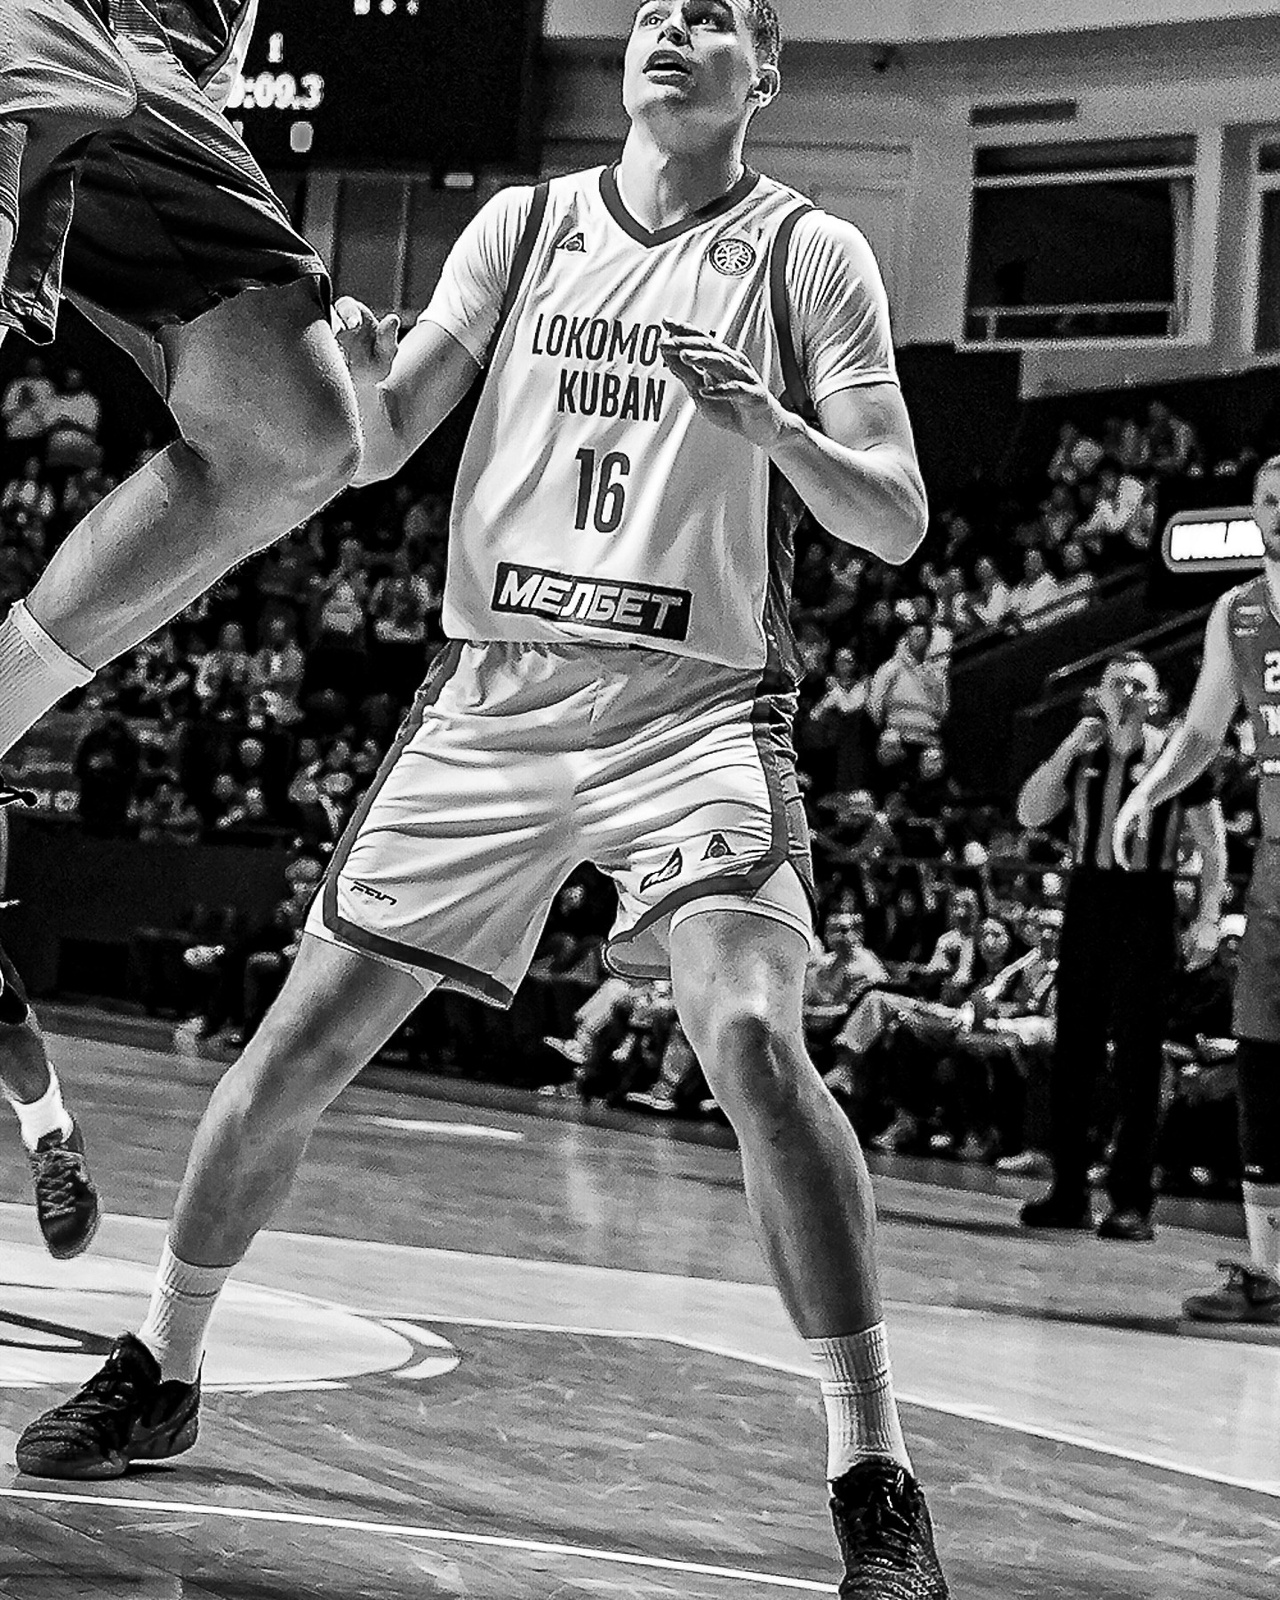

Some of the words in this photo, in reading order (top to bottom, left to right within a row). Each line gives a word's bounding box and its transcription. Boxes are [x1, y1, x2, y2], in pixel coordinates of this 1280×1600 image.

[531, 312, 669, 368] LOKOMO
[557, 367, 667, 422] KUBAN
[574, 447, 632, 534] 16
